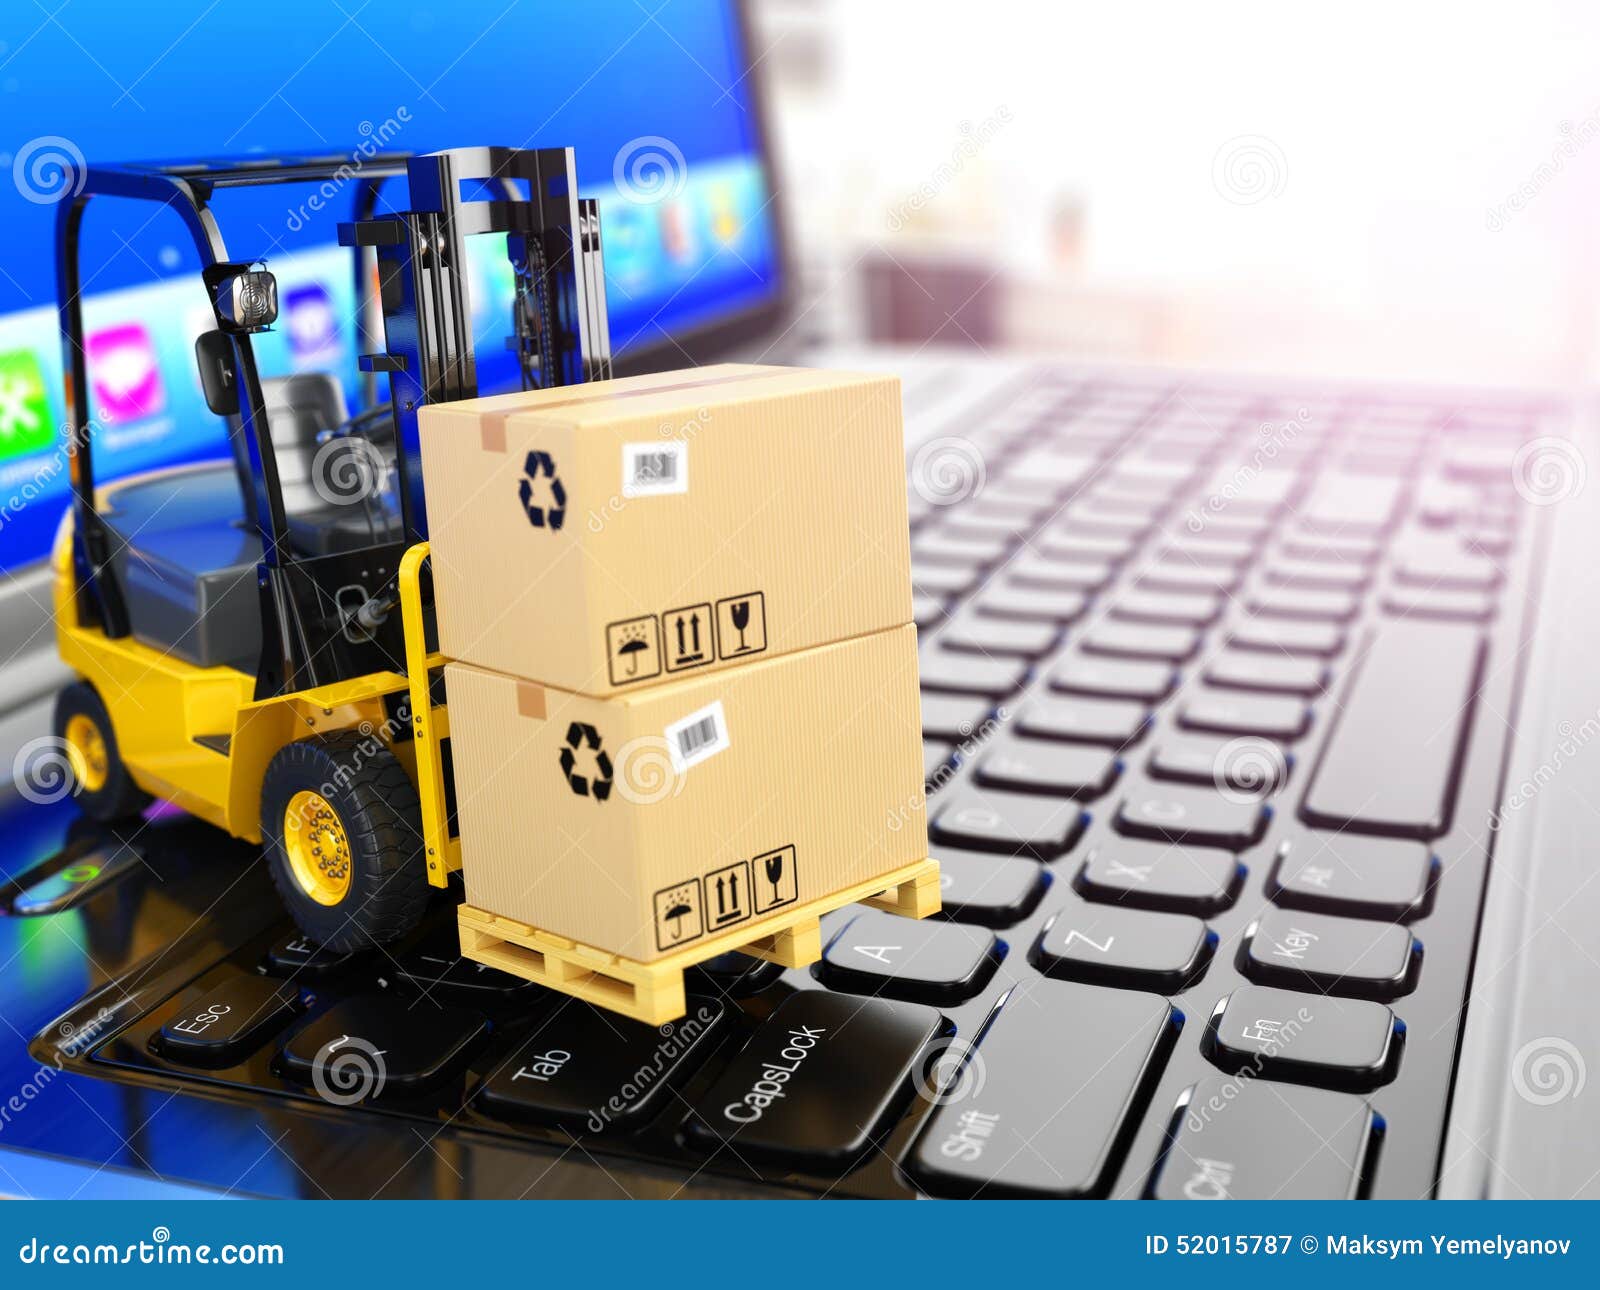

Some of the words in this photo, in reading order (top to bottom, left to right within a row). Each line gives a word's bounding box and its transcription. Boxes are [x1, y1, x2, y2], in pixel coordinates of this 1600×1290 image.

[1105, 859, 1153, 882] X
[853, 943, 903, 964] A
[1064, 929, 1114, 952] Z
[1273, 927, 1320, 960] Key
[173, 1003, 231, 1036] Esc
[1242, 1018, 1283, 1043] Fn
[511, 1048, 572, 1083] Tab
[723, 1024, 826, 1123] CapsLock
[941, 1109, 1001, 1162] Shift
